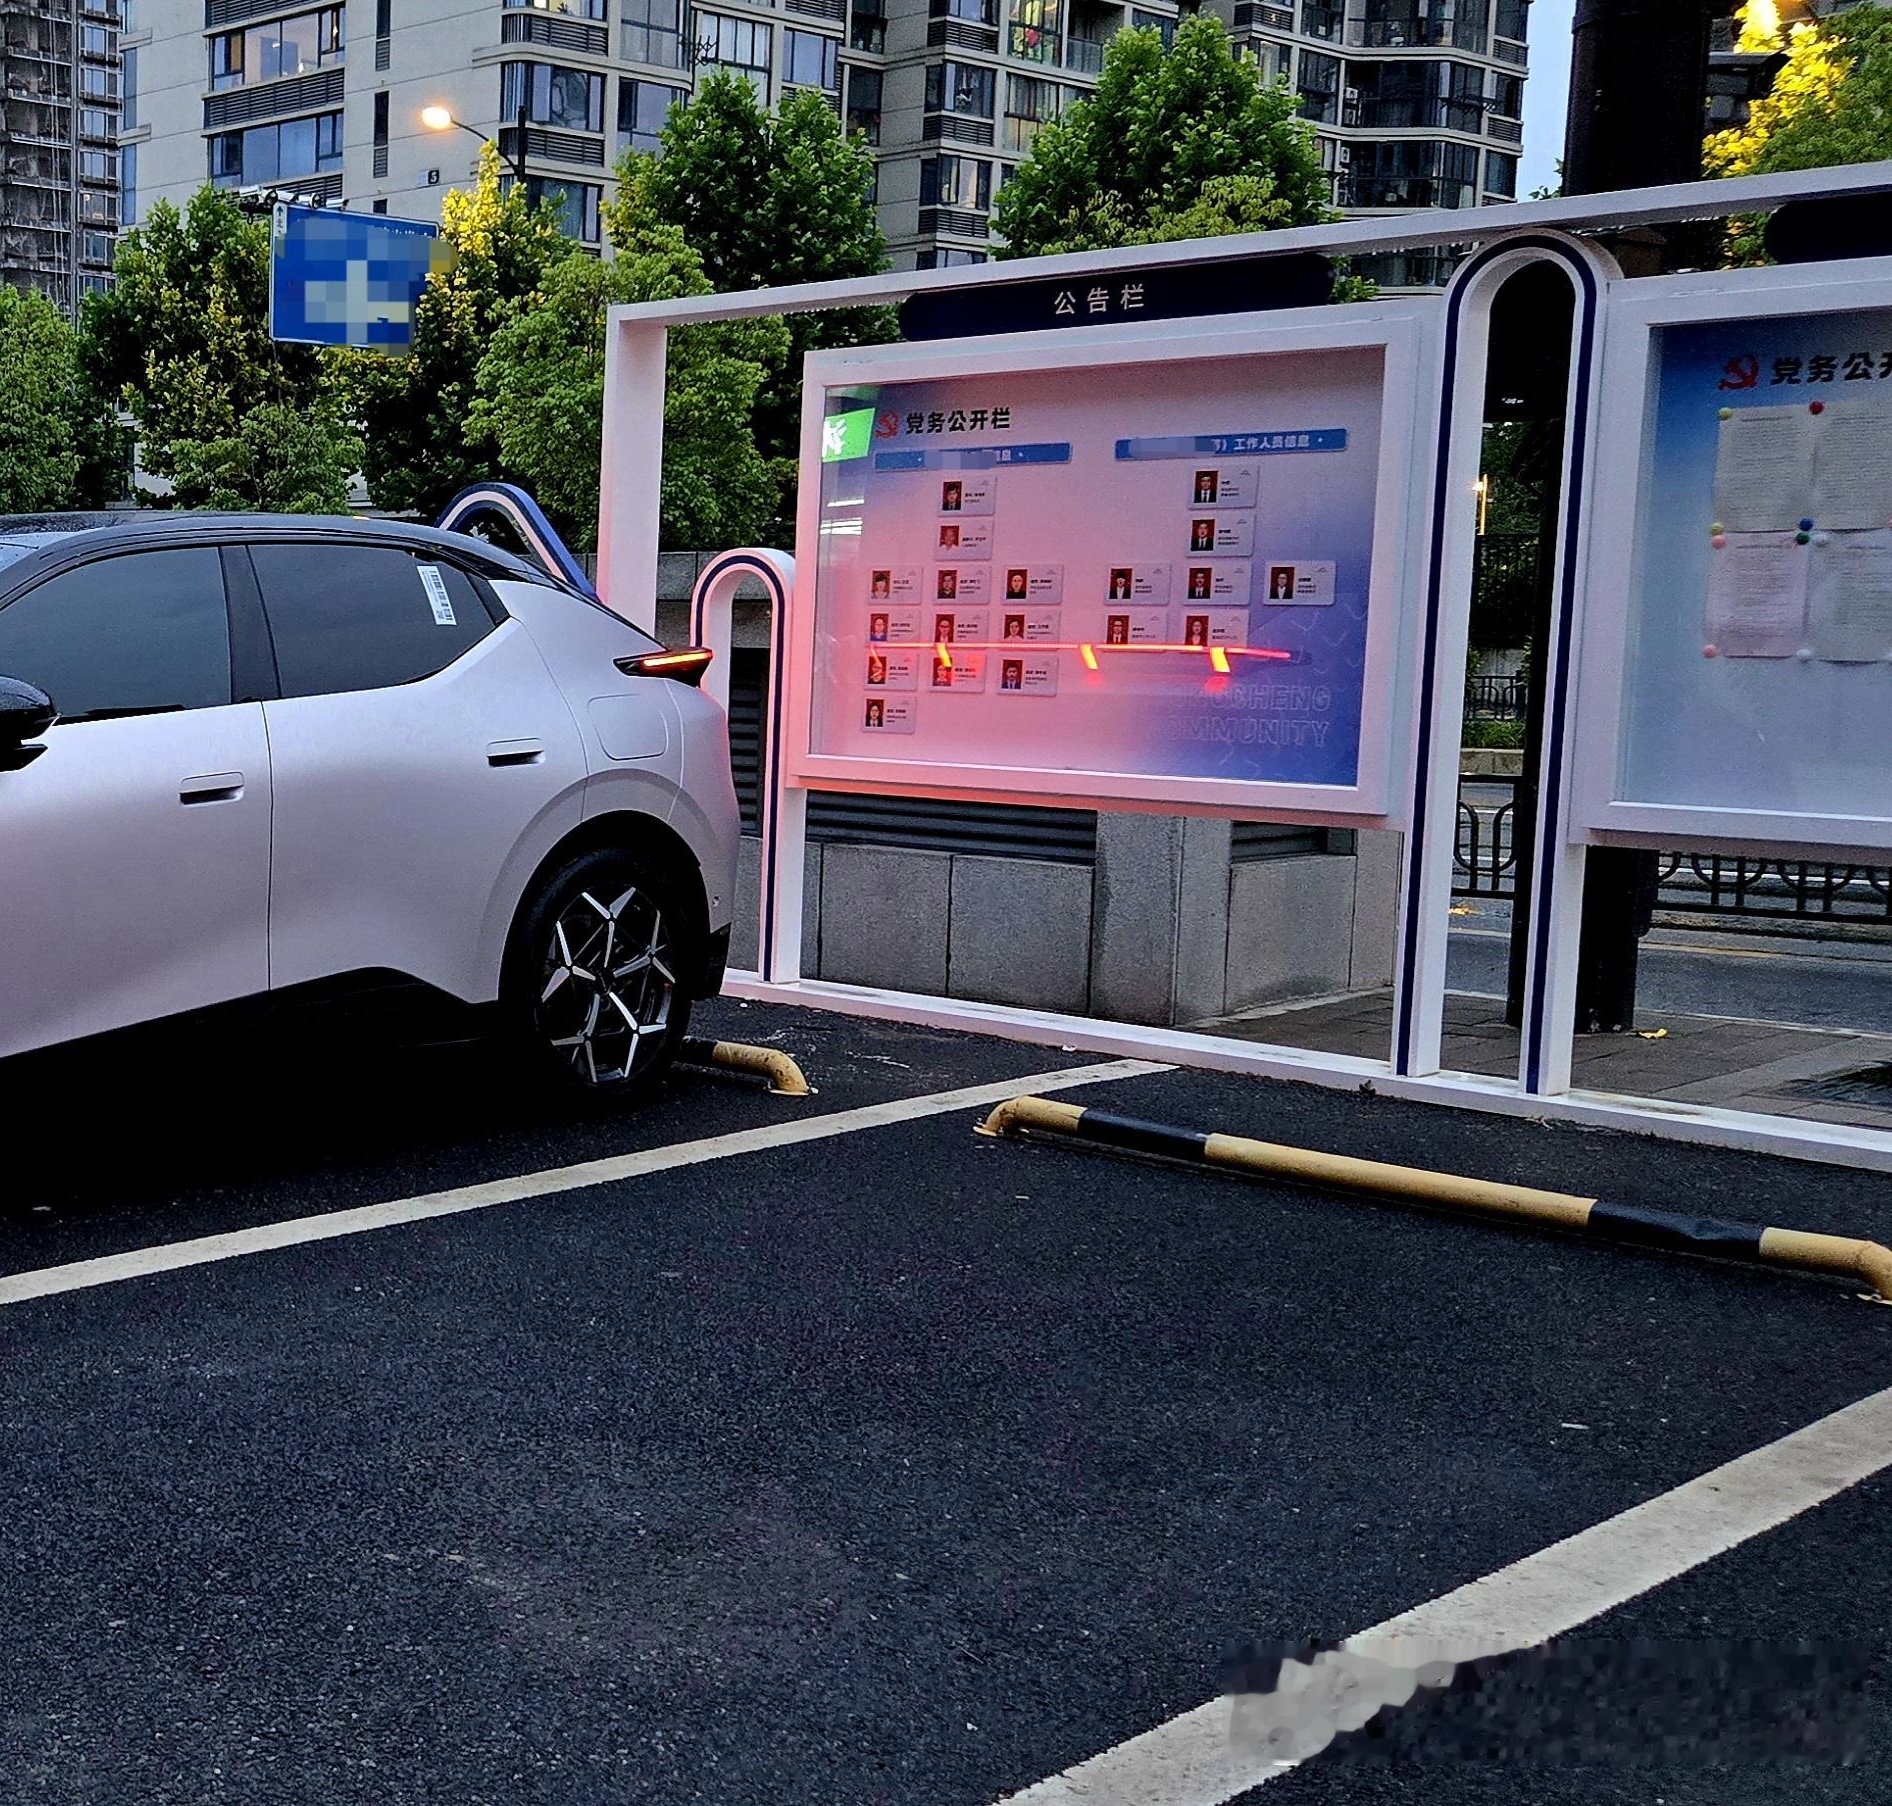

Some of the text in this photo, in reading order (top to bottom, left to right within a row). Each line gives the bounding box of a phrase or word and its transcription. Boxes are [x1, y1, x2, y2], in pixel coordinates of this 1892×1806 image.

[1053, 283, 1145, 315] 公告栏
[906, 407, 1011, 434] 党务公开栏
[1150, 713, 1330, 747] OMMUNITY
